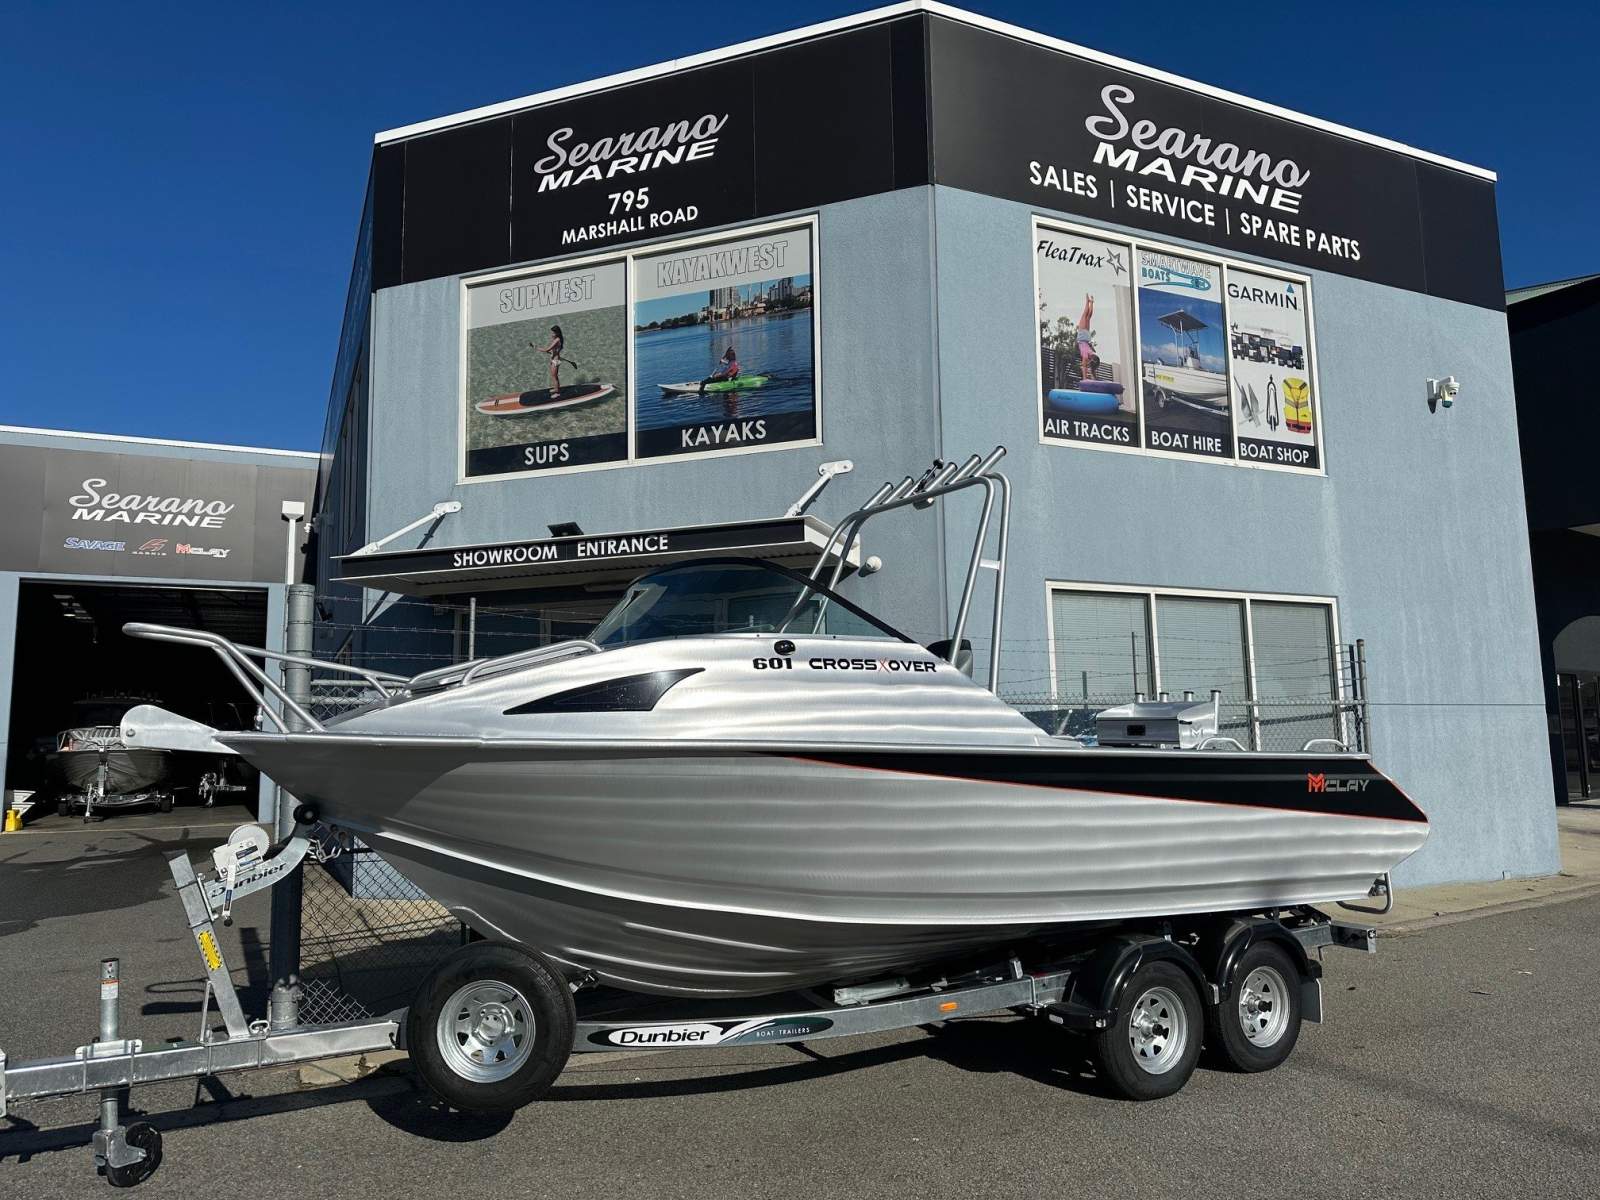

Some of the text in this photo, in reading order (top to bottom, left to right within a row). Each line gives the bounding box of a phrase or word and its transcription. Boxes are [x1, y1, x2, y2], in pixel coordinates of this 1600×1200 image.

[533, 113, 729, 174] Searano
[1085, 84, 1310, 188] Searano
[537, 138, 719, 193] MARINE
[1092, 142, 1303, 214] MARINE
[608, 187, 650, 216] 795
[1029, 161, 1361, 261] SALES SERVICE SPARE PARTS
[561, 206, 698, 245] MARSHALL ROAD
[657, 240, 789, 289] KAYAKWEST
[1037, 240, 1105, 269] FleaTrax
[1141, 267, 1171, 283] BOATS
[499, 274, 596, 314] SUPWEST
[1228, 282, 1298, 311] GARMIN
[681, 419, 767, 448] KAYAKS
[1044, 417, 1131, 443] AIR TRACKS
[1151, 430, 1223, 453] BOAT HIRE
[524, 443, 570, 466] SUPS
[1240, 442, 1311, 464] BOAT SHOP
[69, 478, 235, 516] Searano
[71, 508, 227, 529] MARINE
[453, 534, 669, 567] SHOWROOM ENTRANCE
[752, 657, 793, 670] 601
[211, 863, 287, 898] Dnbier
[619, 1029, 710, 1044] Dunbier
[779, 1027, 810, 1035] TRAILERS
